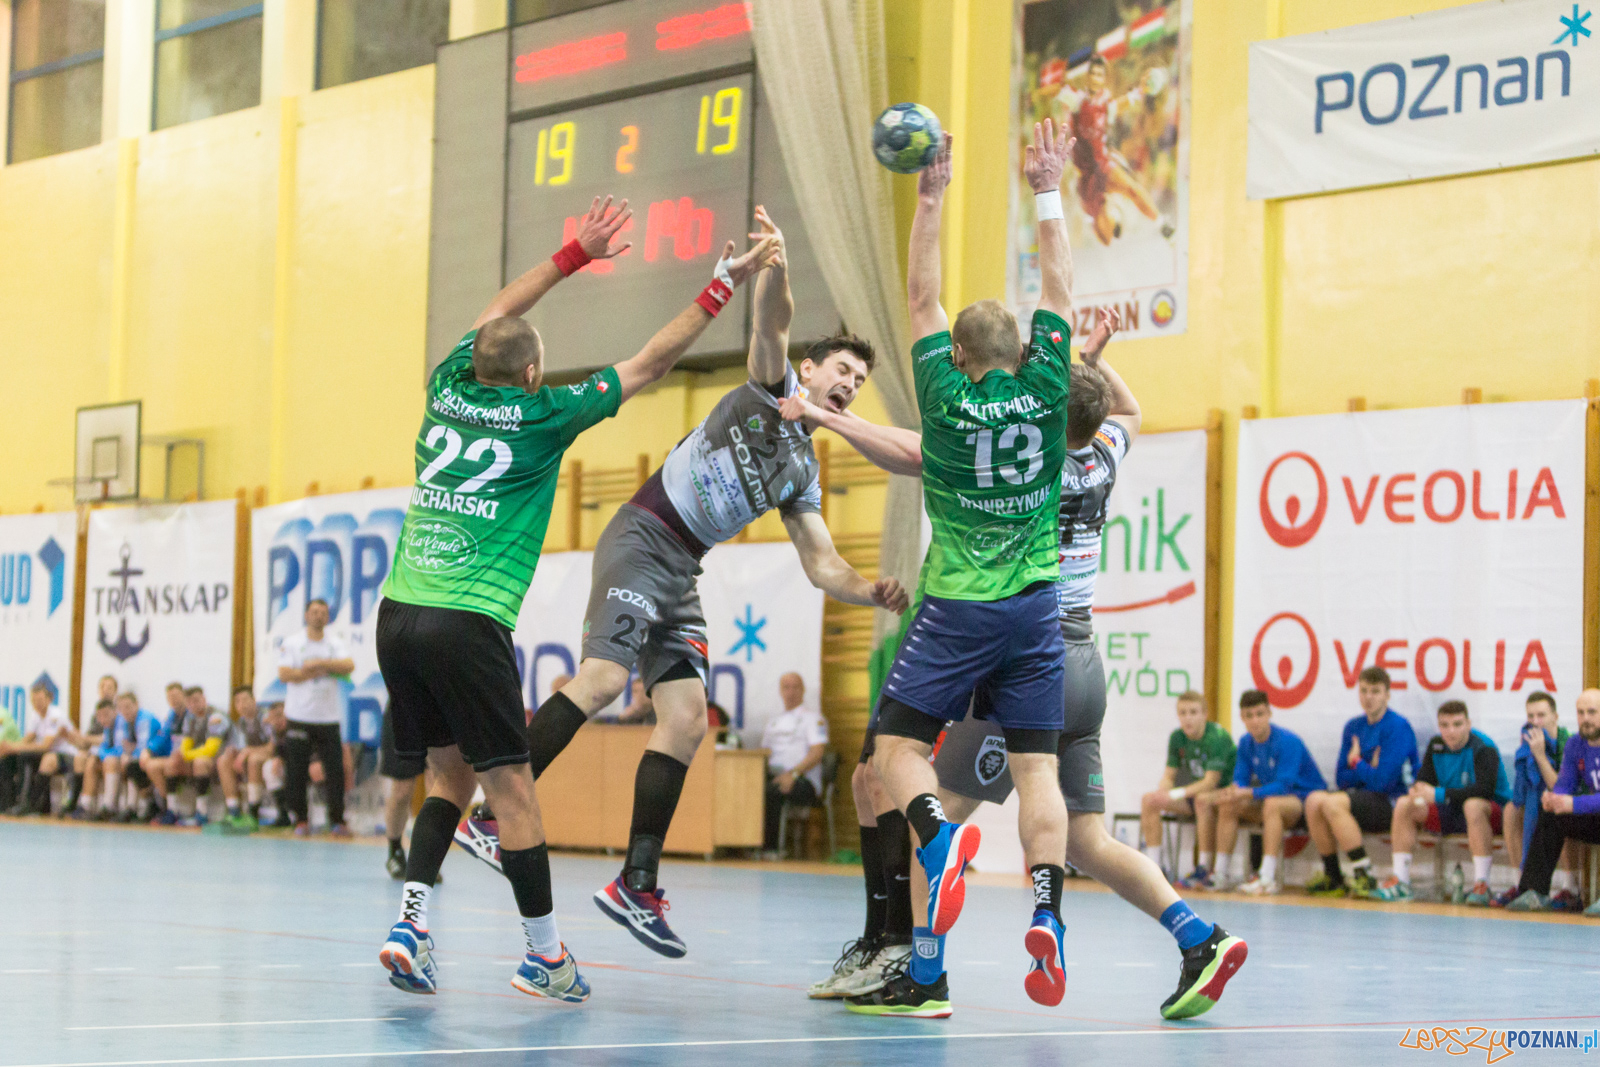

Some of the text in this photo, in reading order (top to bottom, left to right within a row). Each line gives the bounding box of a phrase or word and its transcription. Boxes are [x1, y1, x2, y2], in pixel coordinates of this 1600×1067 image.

[615, 125, 640, 173] 2
[695, 87, 742, 155] 19
[534, 120, 576, 186] 19
[418, 424, 513, 493] 22
[747, 438, 788, 488] 21
[965, 423, 1044, 488] 13
[1342, 467, 1566, 525] VEOLIA
[92, 582, 229, 616] TRANSKAP
[1095, 632, 1151, 660] ET
[1333, 637, 1558, 693] VEOLIA
